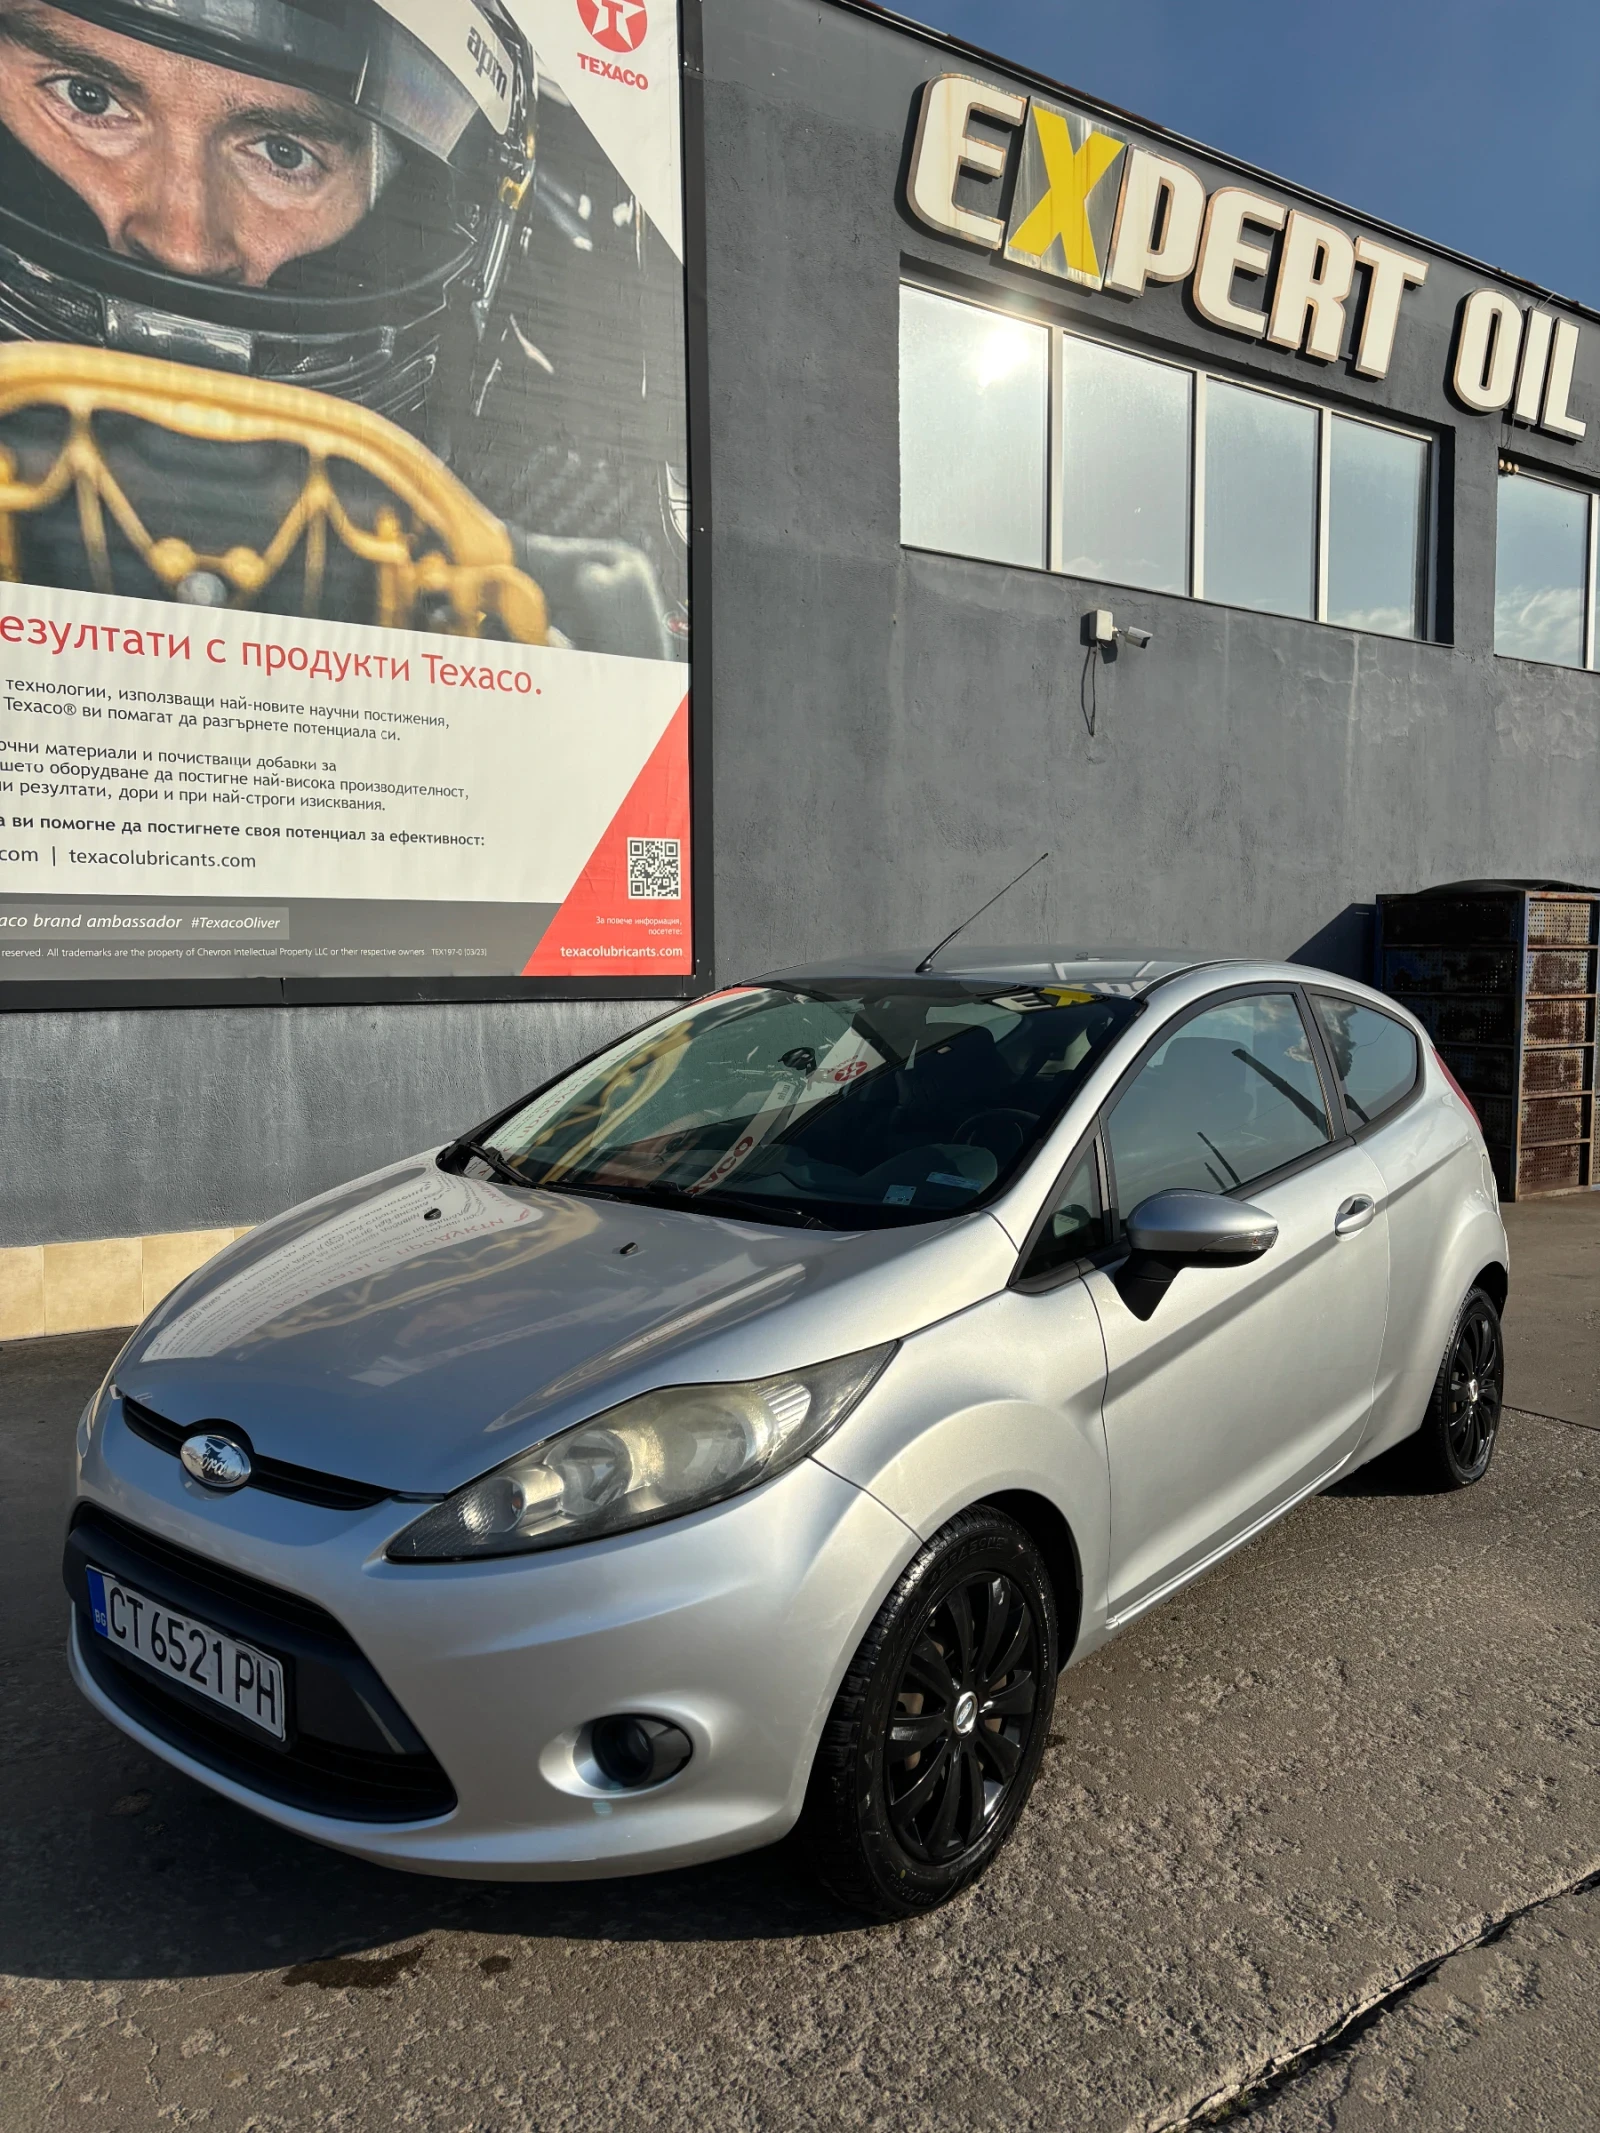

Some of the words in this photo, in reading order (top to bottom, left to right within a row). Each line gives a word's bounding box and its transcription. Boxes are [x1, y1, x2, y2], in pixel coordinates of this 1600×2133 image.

[577, 52, 648, 90] TEXACO
[907, 73, 1429, 379] EXPERT
[1454, 288, 1587, 440] OIL
[206, 639, 226, 662] с
[242, 641, 410, 682] продукти
[6, 679, 112, 701] технологии,
[118, 688, 215, 709] използващи
[220, 697, 305, 714] най-новите
[310, 705, 358, 720] научни
[364, 709, 450, 729] постижения,
[82, 705, 101, 718] ви
[108, 708, 172, 724] помагат
[178, 712, 197, 727] да
[203, 716, 289, 733] разгърнете
[294, 724, 376, 740] потенциала
[381, 728, 400, 741] си.
[46, 744, 137, 761] материали
[143, 752, 152, 761] и
[159, 752, 250, 767] почистващи
[256, 755, 317, 770] добавки
[322, 760, 336, 772] за
[50, 763, 148, 781] оборудване
[154, 768, 173, 782] да
[179, 770, 248, 785] постигне
[253, 773, 335, 791] най-висока
[340, 779, 469, 799] производителност,
[0, 781, 13, 791] и
[20, 783, 111, 800] резултати,
[118, 786, 158, 801] дори
[164, 791, 173, 800] и
[179, 791, 207, 804] при
[213, 791, 295, 807] най-строги
[300, 796, 385, 811] изисквания.
[12, 817, 34, 828] ви
[40, 819, 115, 832] помогне
[121, 822, 141, 834] да
[148, 822, 240, 836] постигнете
[245, 826, 280, 837] своя
[286, 827, 366, 842] потенциал
[371, 831, 385, 842] за
[390, 831, 485, 846] ефективност:
[69, 849, 255, 868] texacolubricants.com
[33, 913, 81, 928] brand
[87, 915, 182, 929] ambassador
[191, 916, 280, 929] #TexacoOliver
[2, 948, 44, 957] reserved.
[560, 946, 682, 956] texacolubricants.com
[95, 1608, 107, 1627] BG
